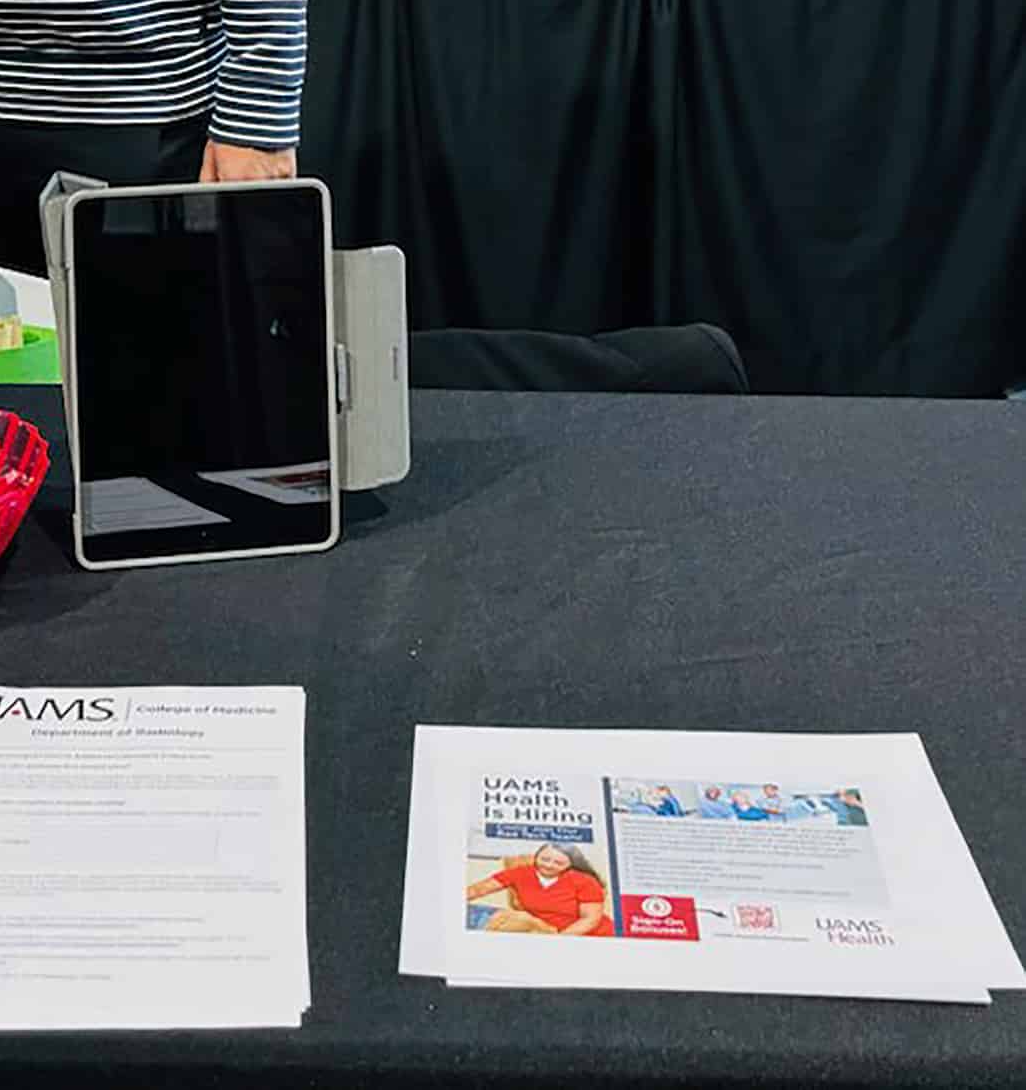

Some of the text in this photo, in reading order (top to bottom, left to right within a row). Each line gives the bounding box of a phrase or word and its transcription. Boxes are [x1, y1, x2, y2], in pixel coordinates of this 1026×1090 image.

[485, 777, 560, 792] UAMS
[485, 792, 569, 808] Health
[485, 806, 593, 824] Is Hiring
[815, 917, 883, 932] UAMS
[828, 931, 895, 945] Health
